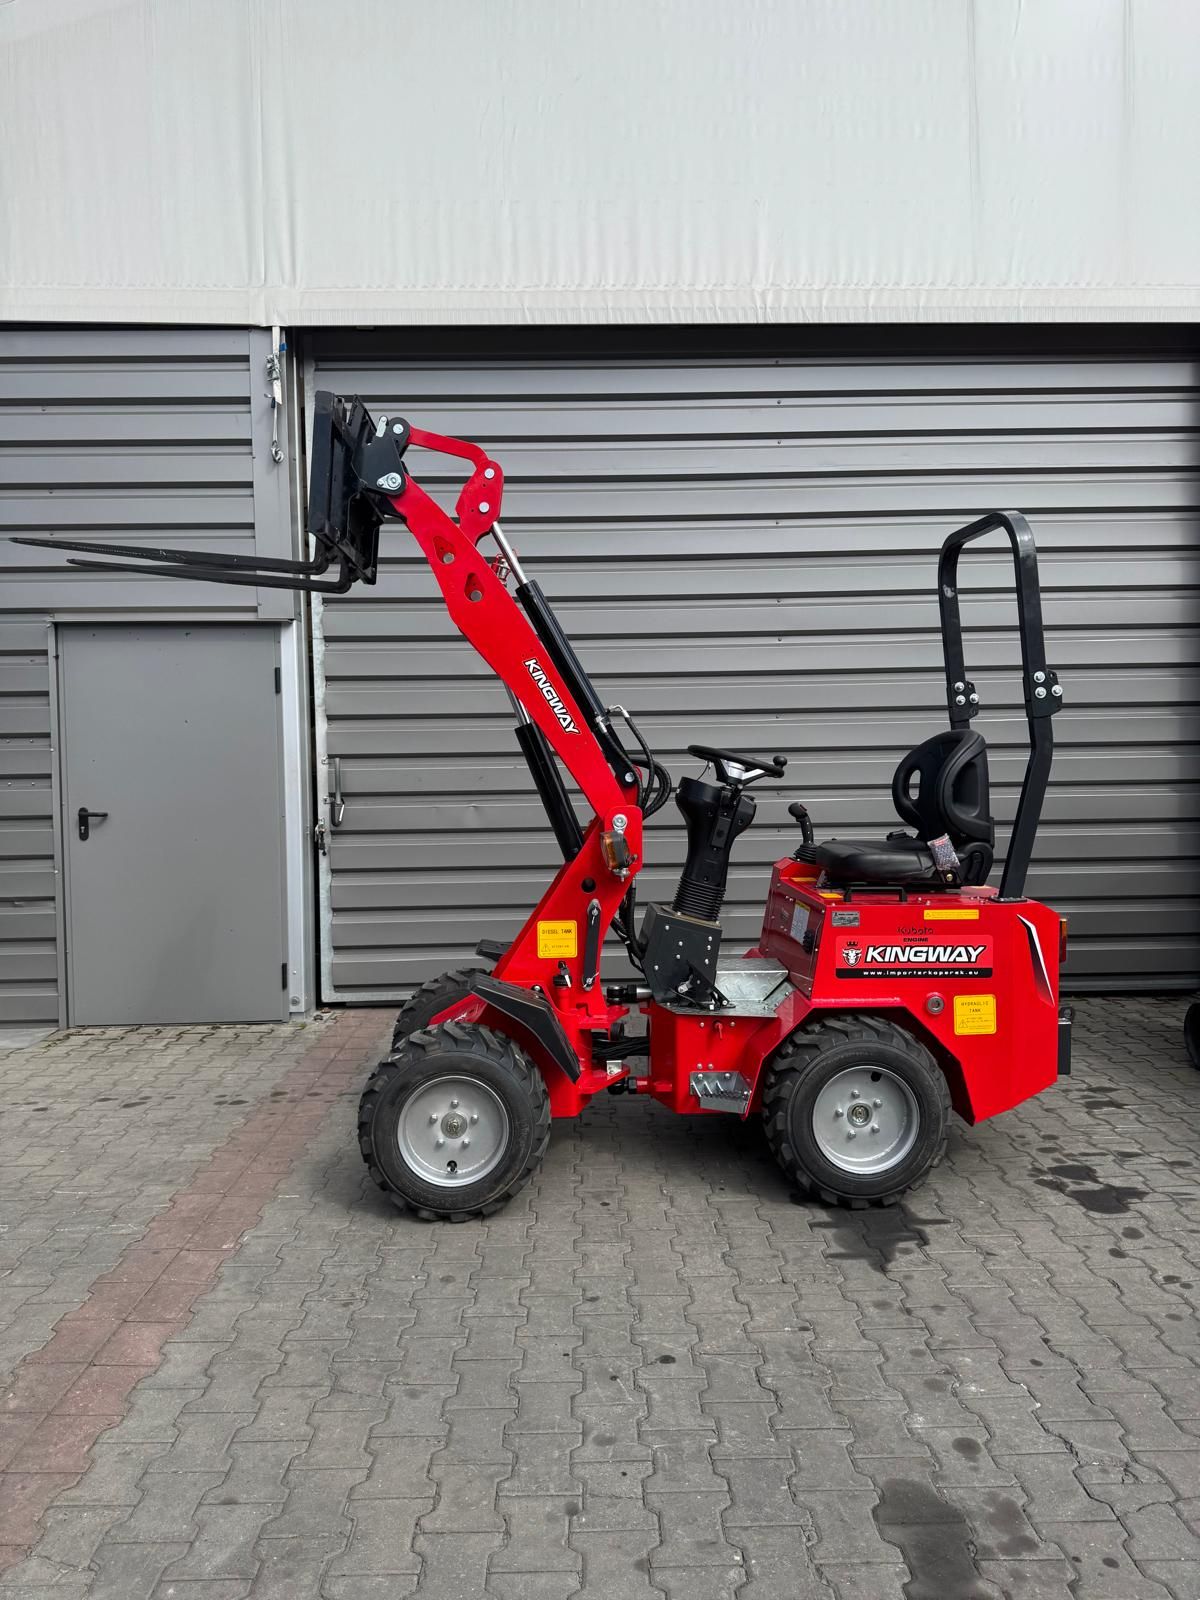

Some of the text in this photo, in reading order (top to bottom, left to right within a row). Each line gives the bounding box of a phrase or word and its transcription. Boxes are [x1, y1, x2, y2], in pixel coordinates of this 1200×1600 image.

[523, 658, 580, 733] KINGWAY
[898, 927, 934, 935] Kubota
[865, 945, 987, 963] KINGWAY
